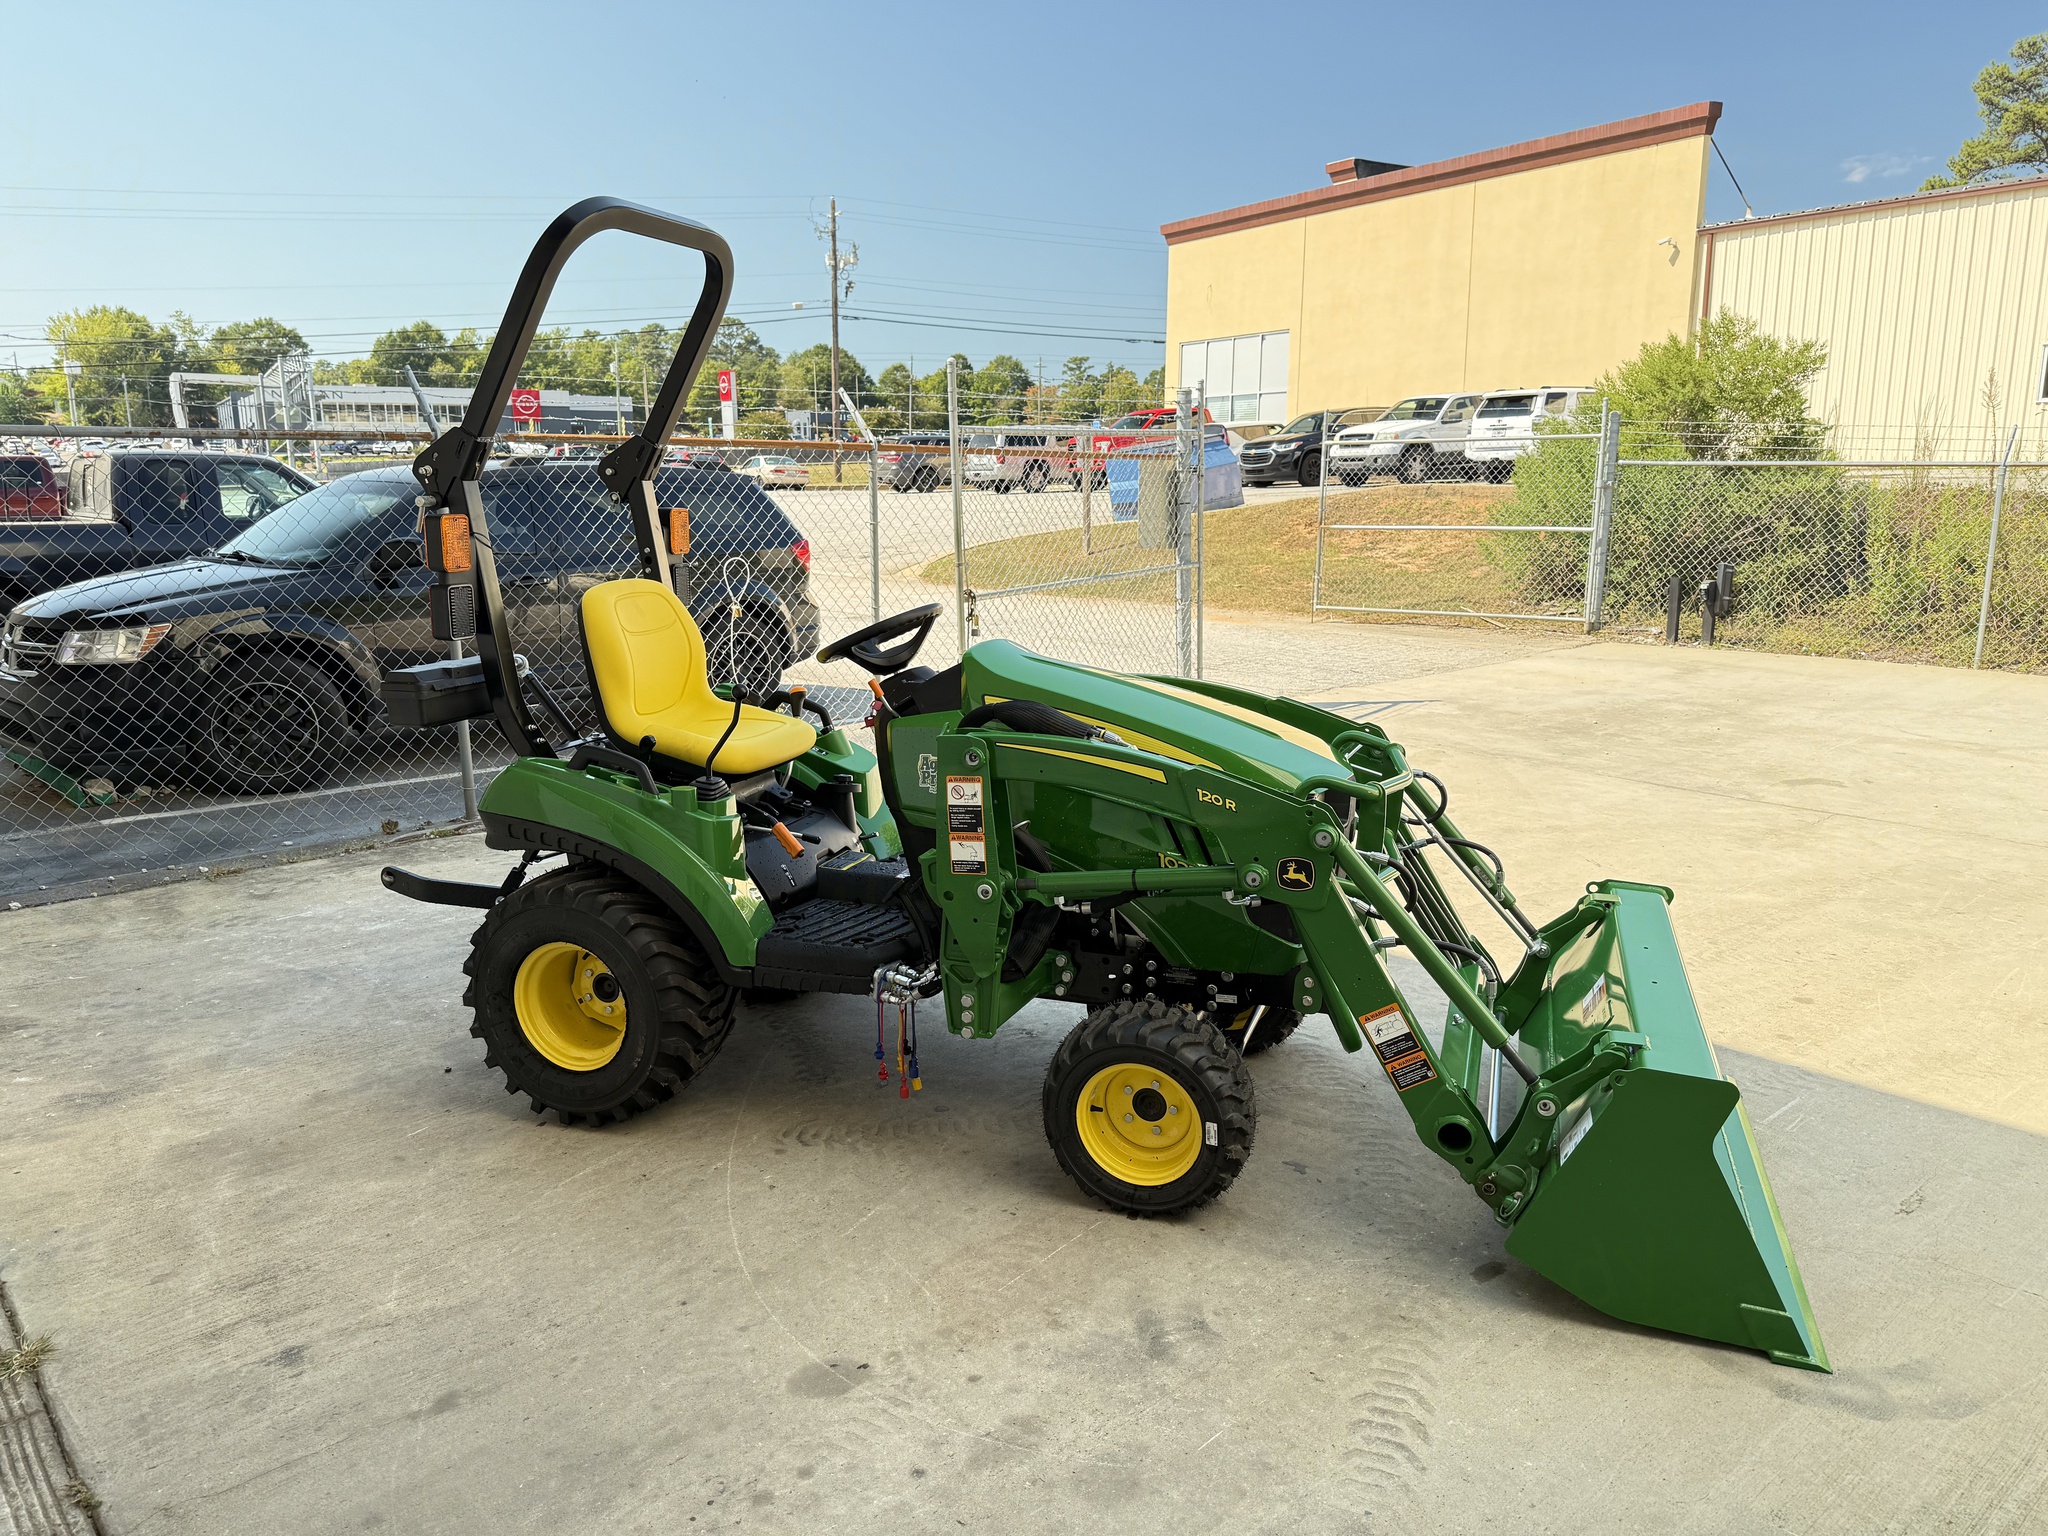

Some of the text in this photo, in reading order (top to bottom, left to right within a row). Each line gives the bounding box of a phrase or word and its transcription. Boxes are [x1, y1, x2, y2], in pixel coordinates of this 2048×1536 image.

[1197, 788, 1237, 812] 120 R
[1370, 1006, 1395, 1019] WARNING
[1397, 1055, 1422, 1067] WARNING
